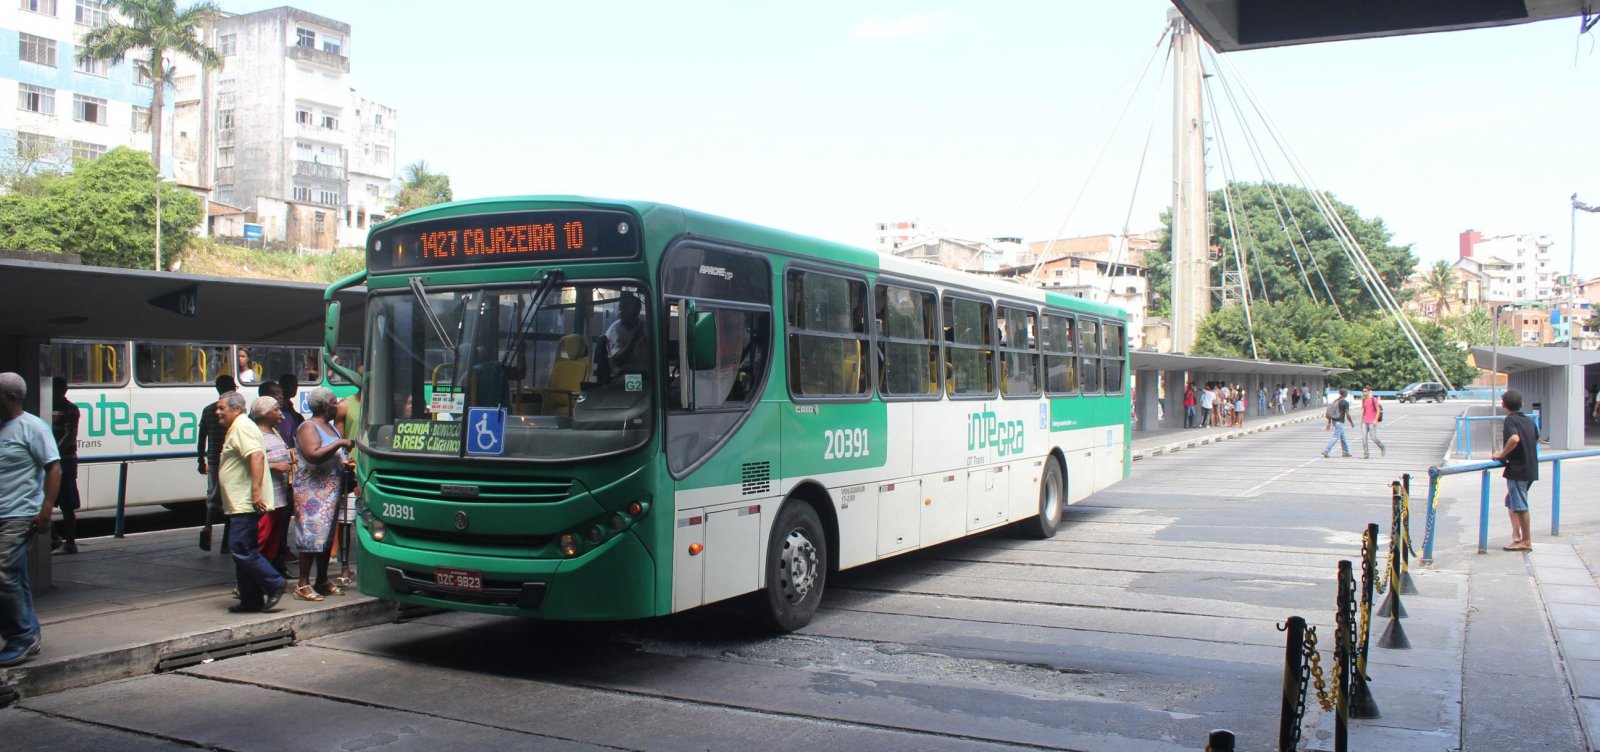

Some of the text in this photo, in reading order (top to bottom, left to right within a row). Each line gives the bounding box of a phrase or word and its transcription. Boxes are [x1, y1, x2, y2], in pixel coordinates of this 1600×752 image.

[420, 221, 584, 258] 1427 CAJAZEIRA 10
[180, 294, 196, 314] 04
[626, 381, 642, 391] G2
[76, 440, 102, 448] Trans
[823, 427, 870, 460] 20391
[382, 502, 415, 521] 20391
